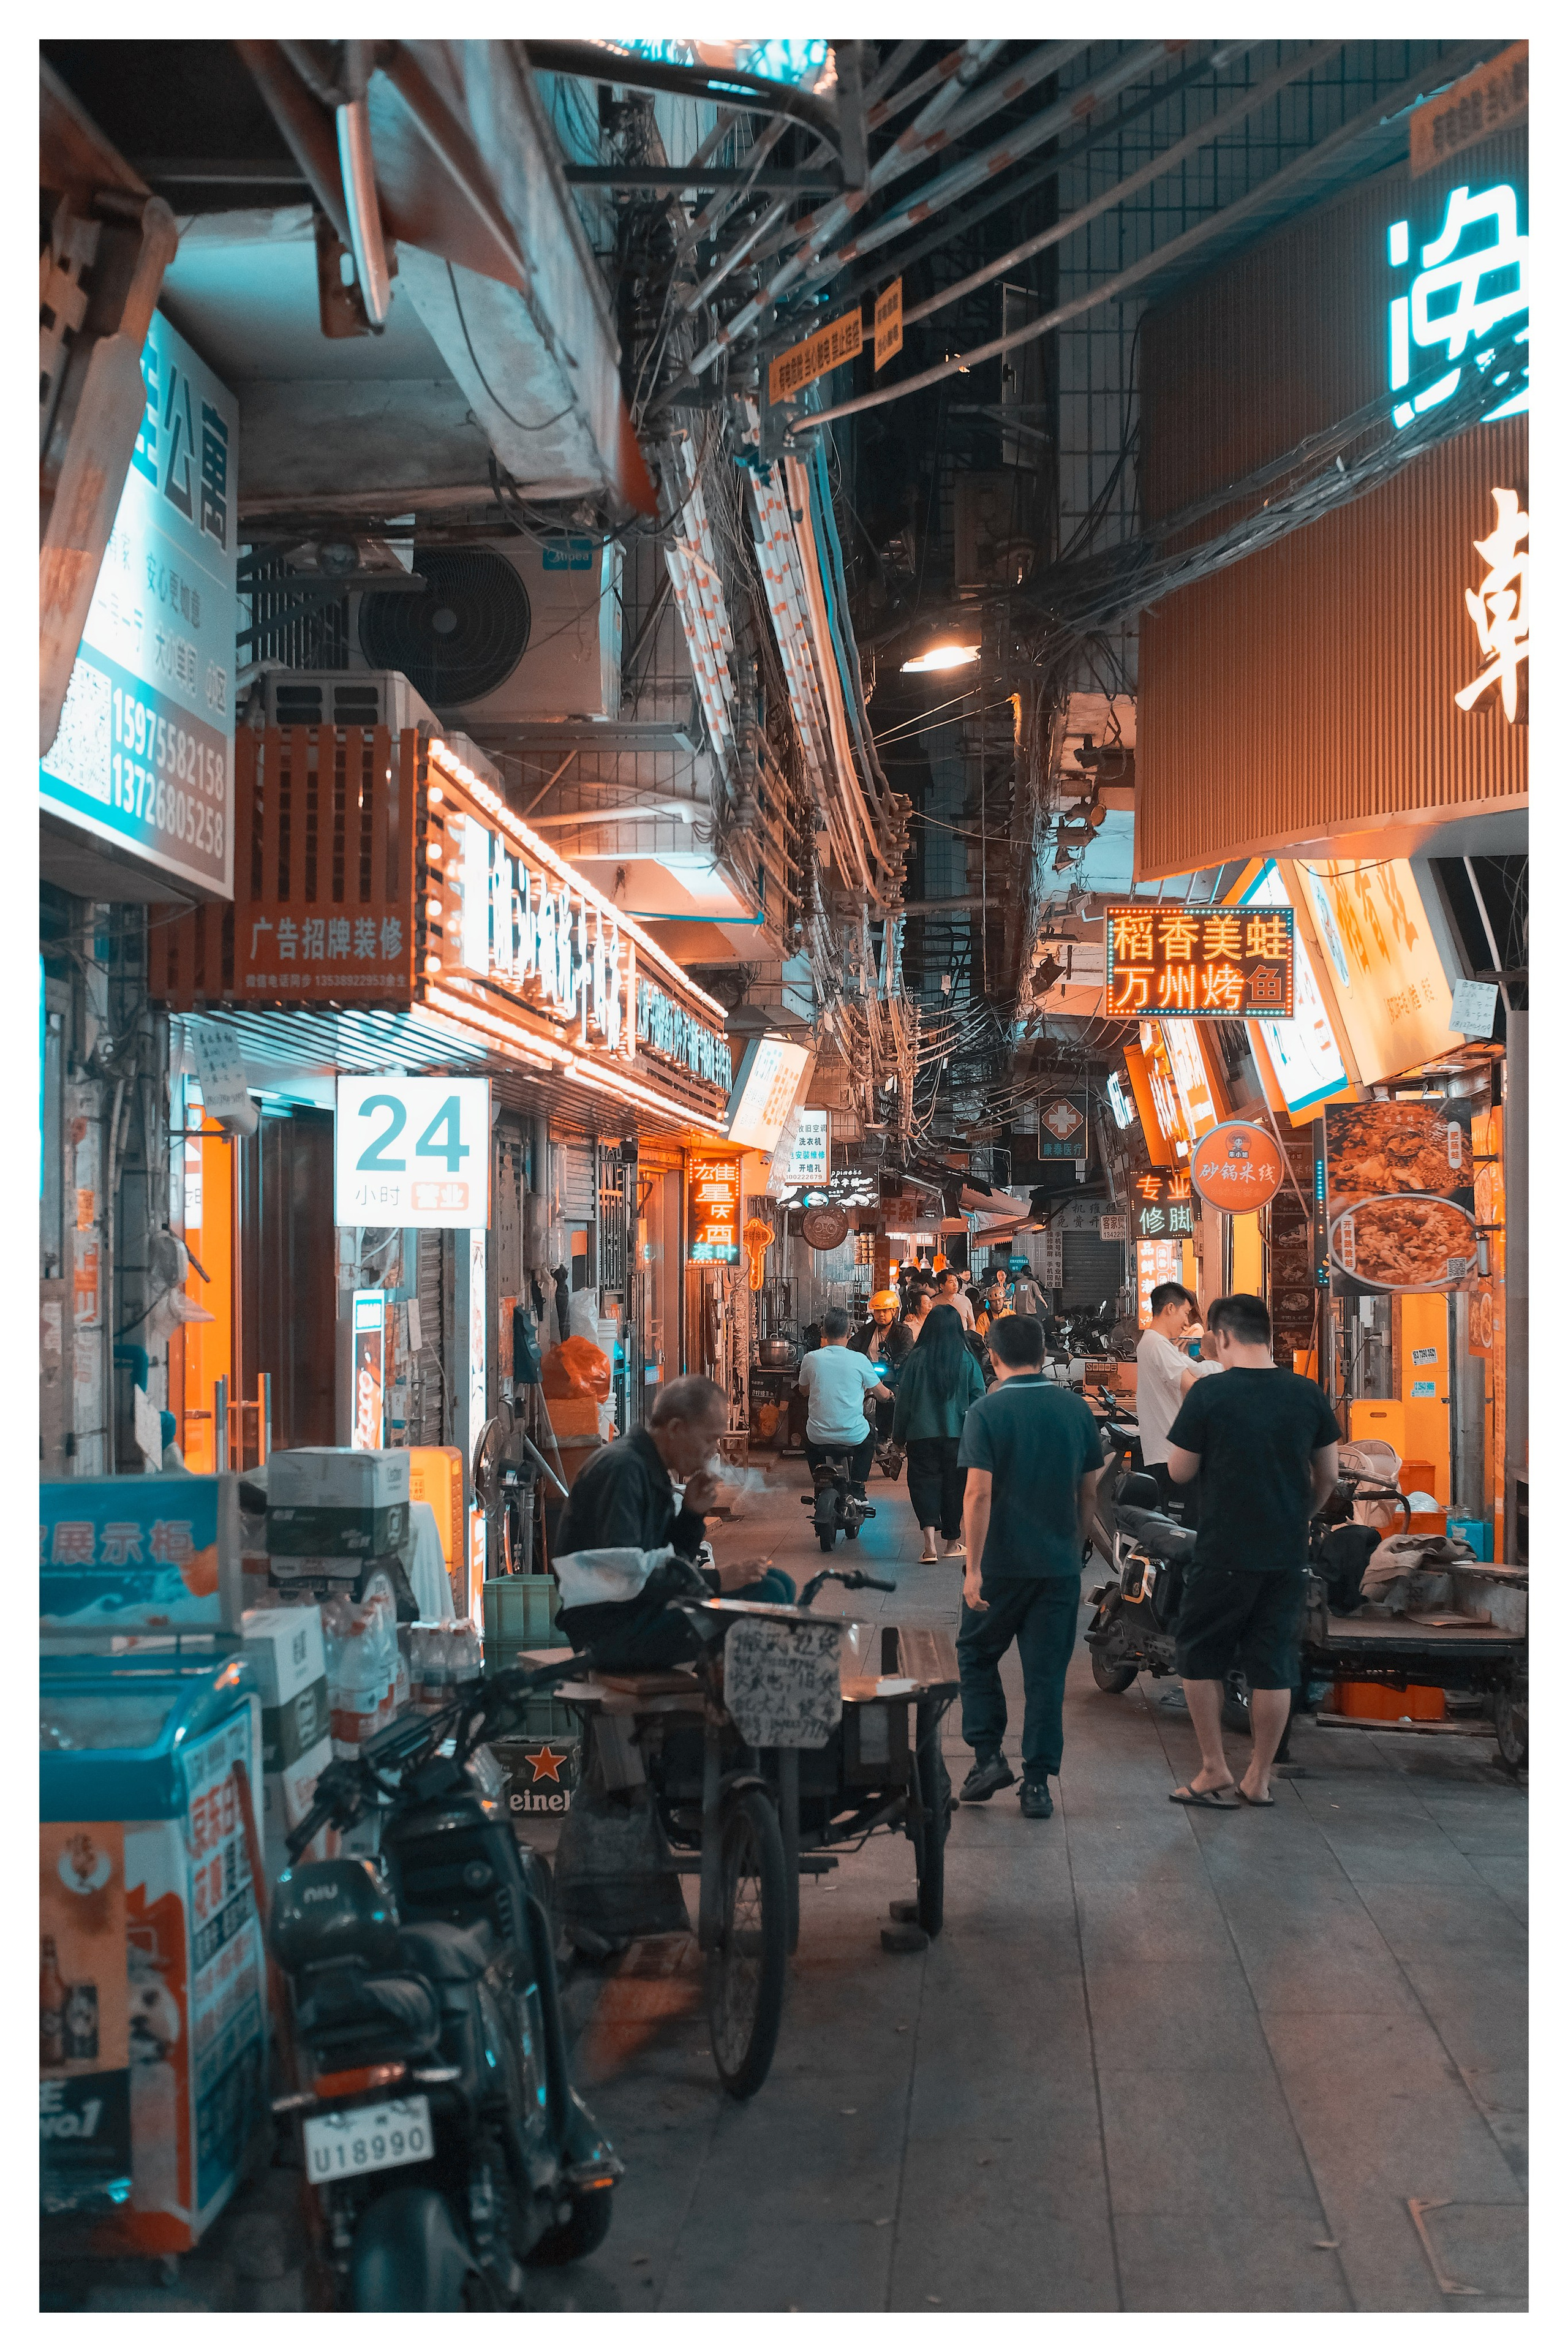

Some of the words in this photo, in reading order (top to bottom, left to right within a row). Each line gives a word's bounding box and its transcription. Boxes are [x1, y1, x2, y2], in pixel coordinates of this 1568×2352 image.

[113, 687, 224, 801] 15975582158
[112, 752, 224, 859] 13726805258
[250, 916, 403, 960] 广告招牌装修
[1114, 914, 1288, 960] 稻香美蛙
[1114, 963, 1286, 1010] 万州烤鱼
[355, 1095, 470, 1172] 24
[1043, 1143, 1083, 1156] 康泰医疗
[799, 1164, 821, 1172] 开墙孔
[1199, 1161, 1276, 1185] 砂锅米线
[356, 1185, 400, 1206] 小时
[415, 1184, 464, 1209] 营业
[1136, 1174, 1194, 1201] 专业
[881, 1199, 914, 1223] 牛杂
[1139, 1205, 1194, 1235] 修脚
[693, 1242, 738, 1262] 茶叶
[314, 2125, 425, 2173] U18990
